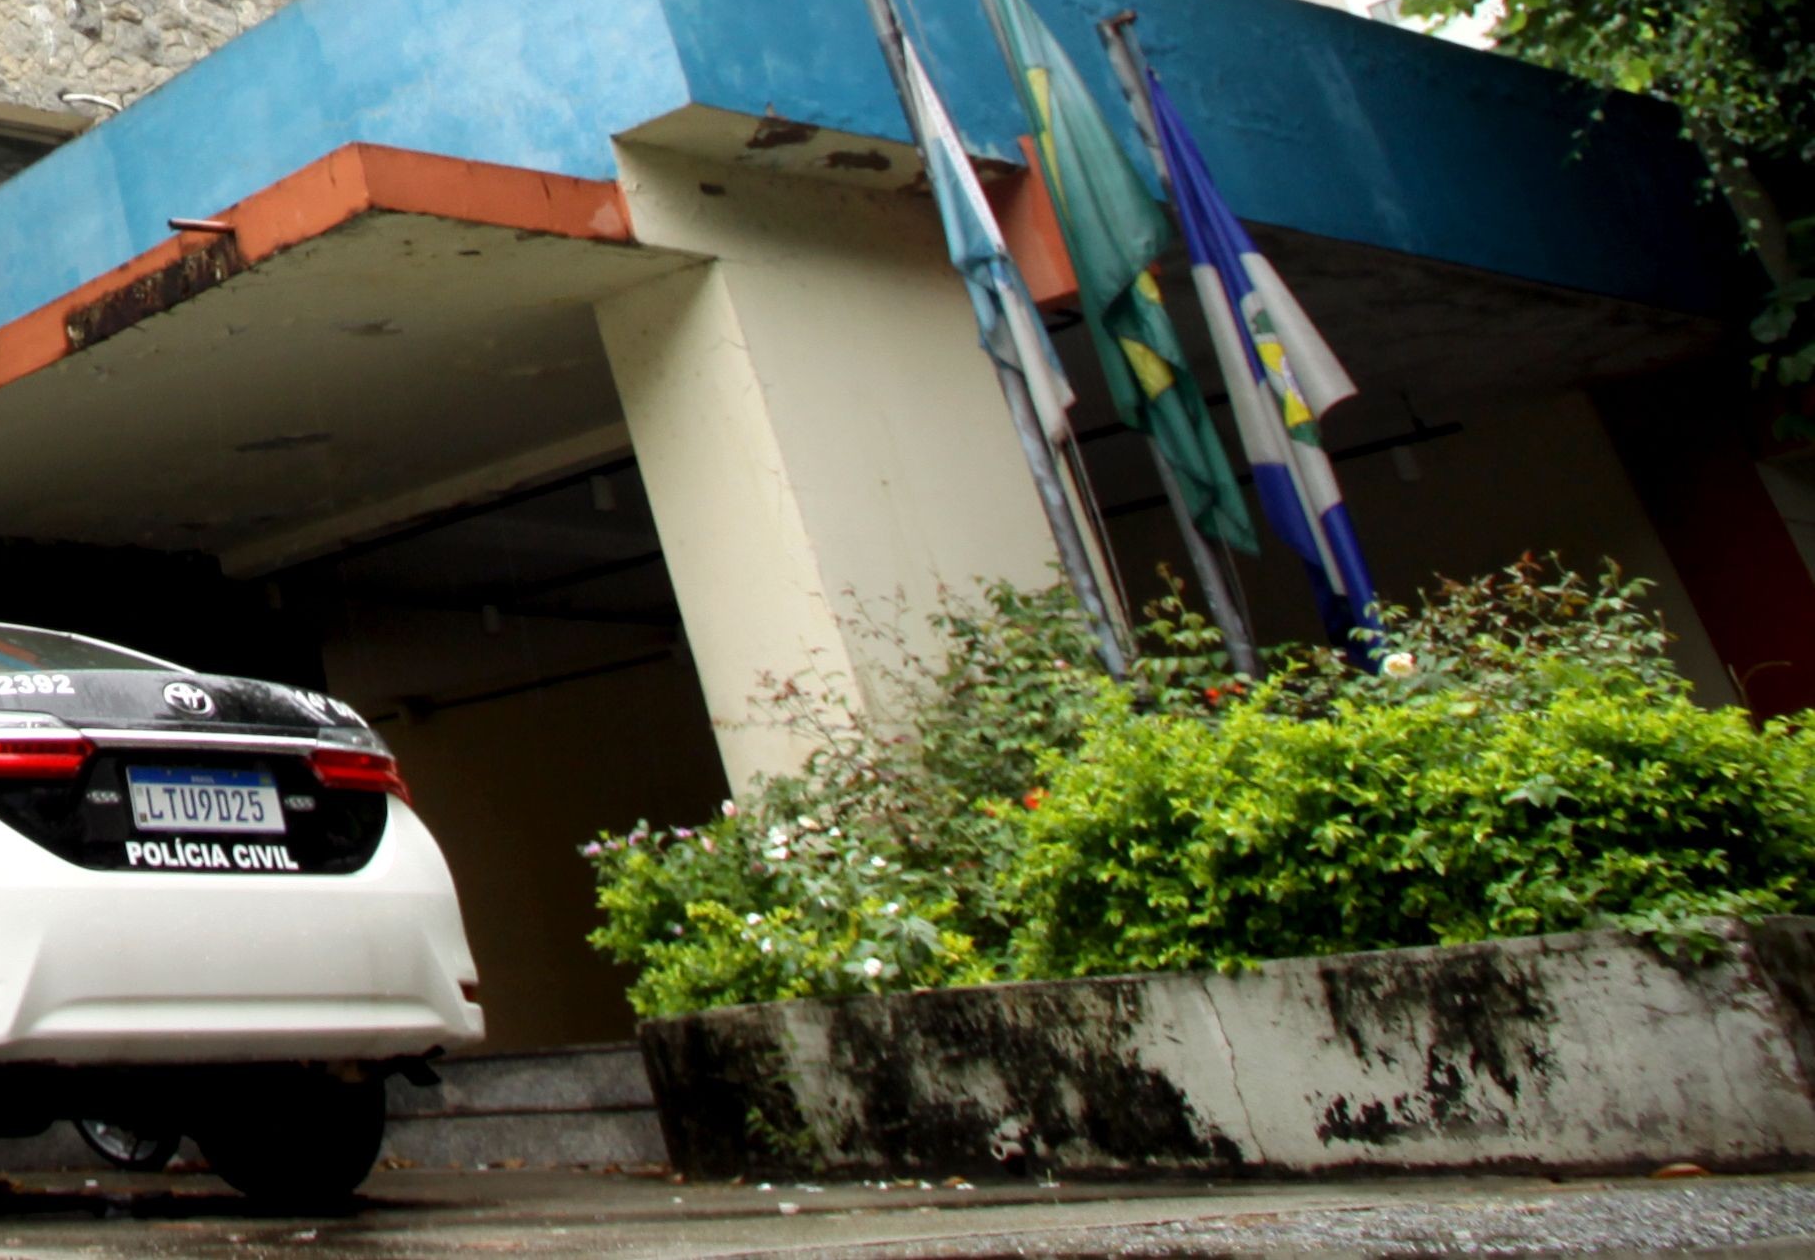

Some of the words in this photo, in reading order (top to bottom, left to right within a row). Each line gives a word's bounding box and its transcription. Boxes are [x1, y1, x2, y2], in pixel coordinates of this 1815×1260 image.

[146, 787, 265, 822] LTU9D25
[125, 838, 230, 868] POLÍCIA
[233, 844, 300, 870] CIVIL
